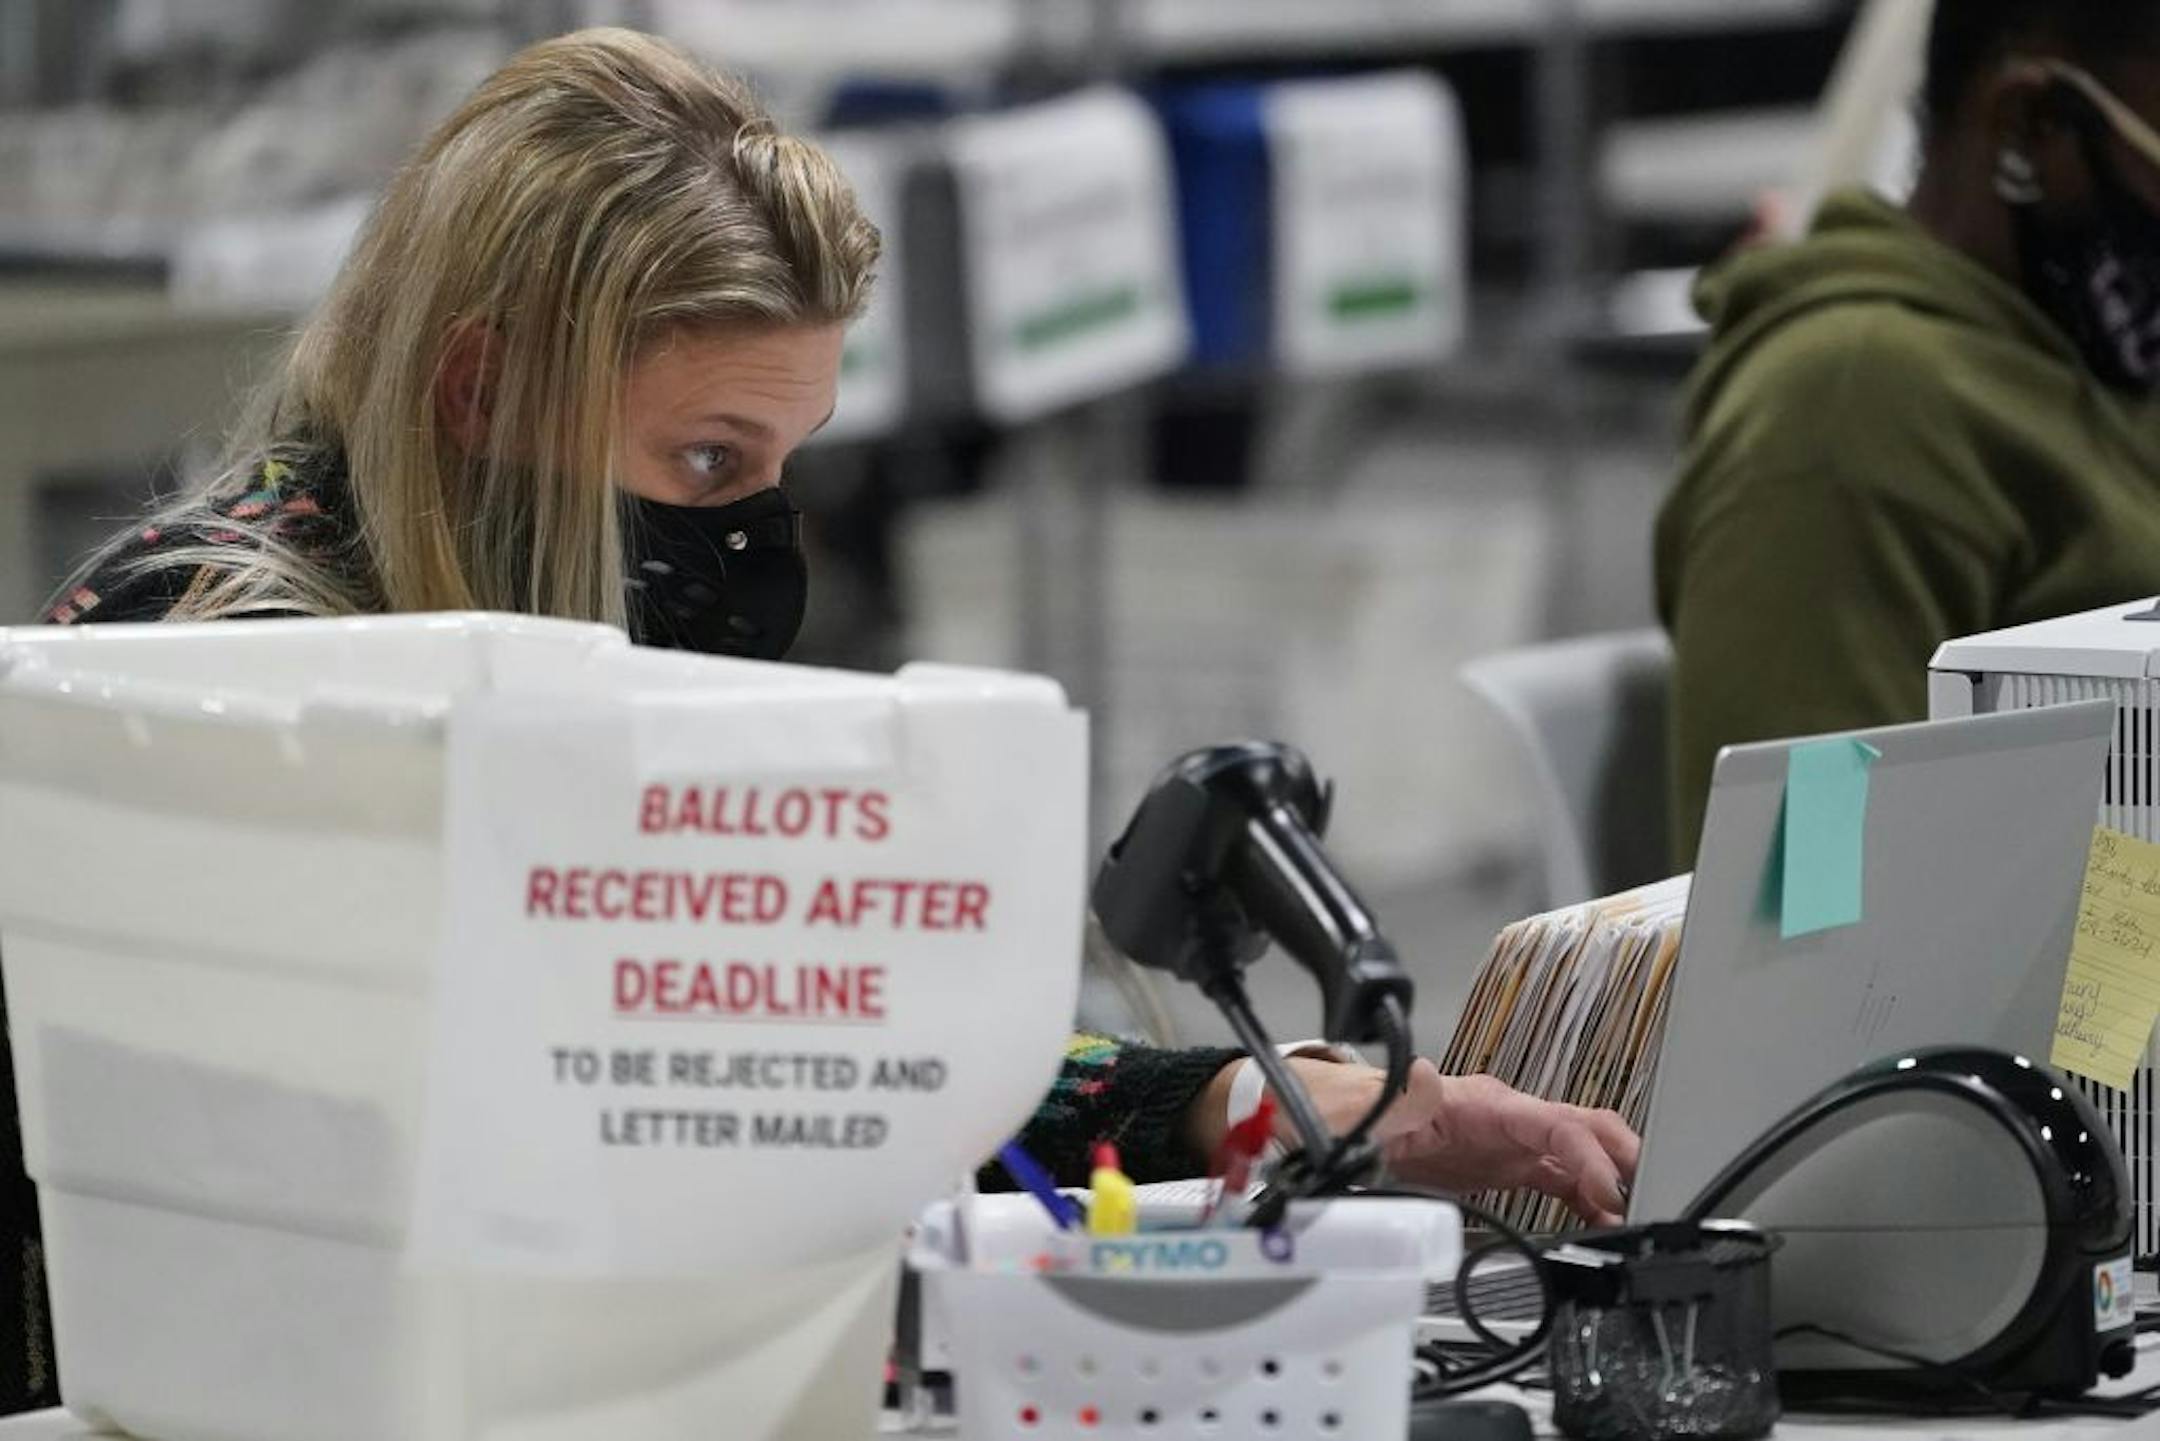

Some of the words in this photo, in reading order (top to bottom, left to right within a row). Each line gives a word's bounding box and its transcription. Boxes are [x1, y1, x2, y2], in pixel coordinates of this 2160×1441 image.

[638, 784, 891, 841] BALLOTS
[526, 867, 789, 924] RECEIVED
[804, 879, 991, 931] AFTER
[613, 958, 886, 1020] DEADLINE
[551, 1047, 600, 1086] TO
[610, 1049, 656, 1087] BE
[669, 1051, 859, 1091] REJECTED
[869, 1058, 948, 1093] AND
[600, 1110, 741, 1148] LETTER
[750, 1114, 889, 1150] MAILED
[1090, 1238, 1229, 1271] DYMO
